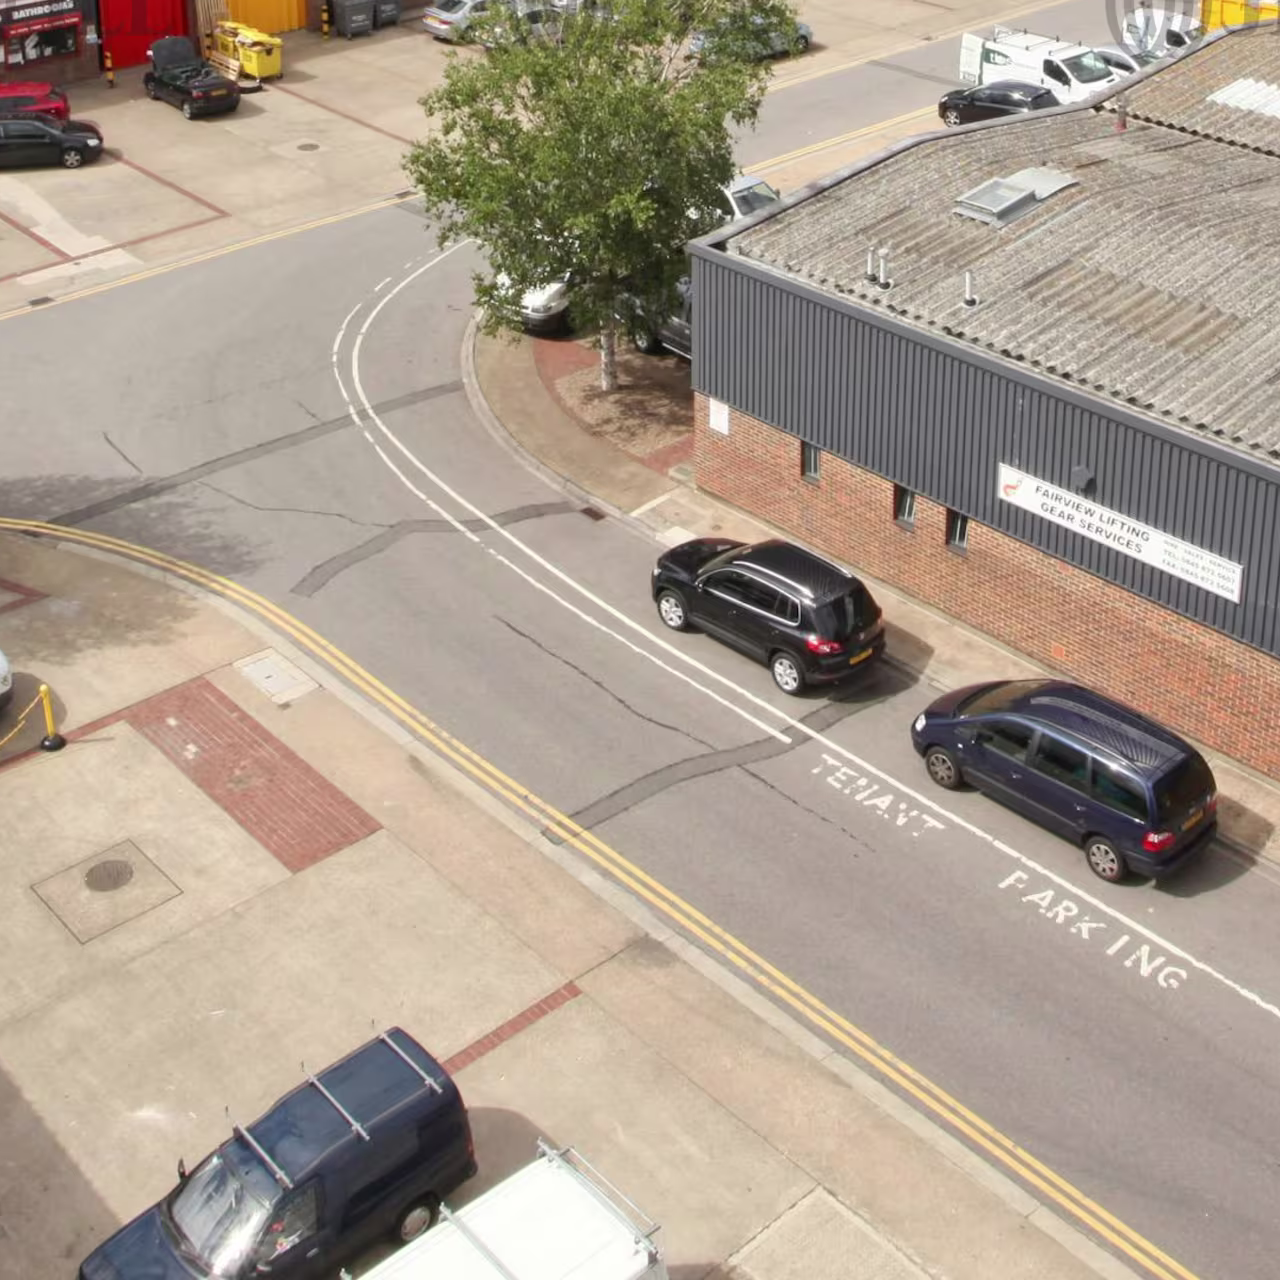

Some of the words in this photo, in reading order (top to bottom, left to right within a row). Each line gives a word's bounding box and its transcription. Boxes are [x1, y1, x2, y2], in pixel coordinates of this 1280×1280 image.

[1035, 484, 1096, 518] FAIRVIEW
[1099, 510, 1151, 543] LIFTING
[1040, 502, 1076, 525] GEAR
[1078, 517, 1143, 554] SERVICES
[998, 869, 1188, 991] PARKING
